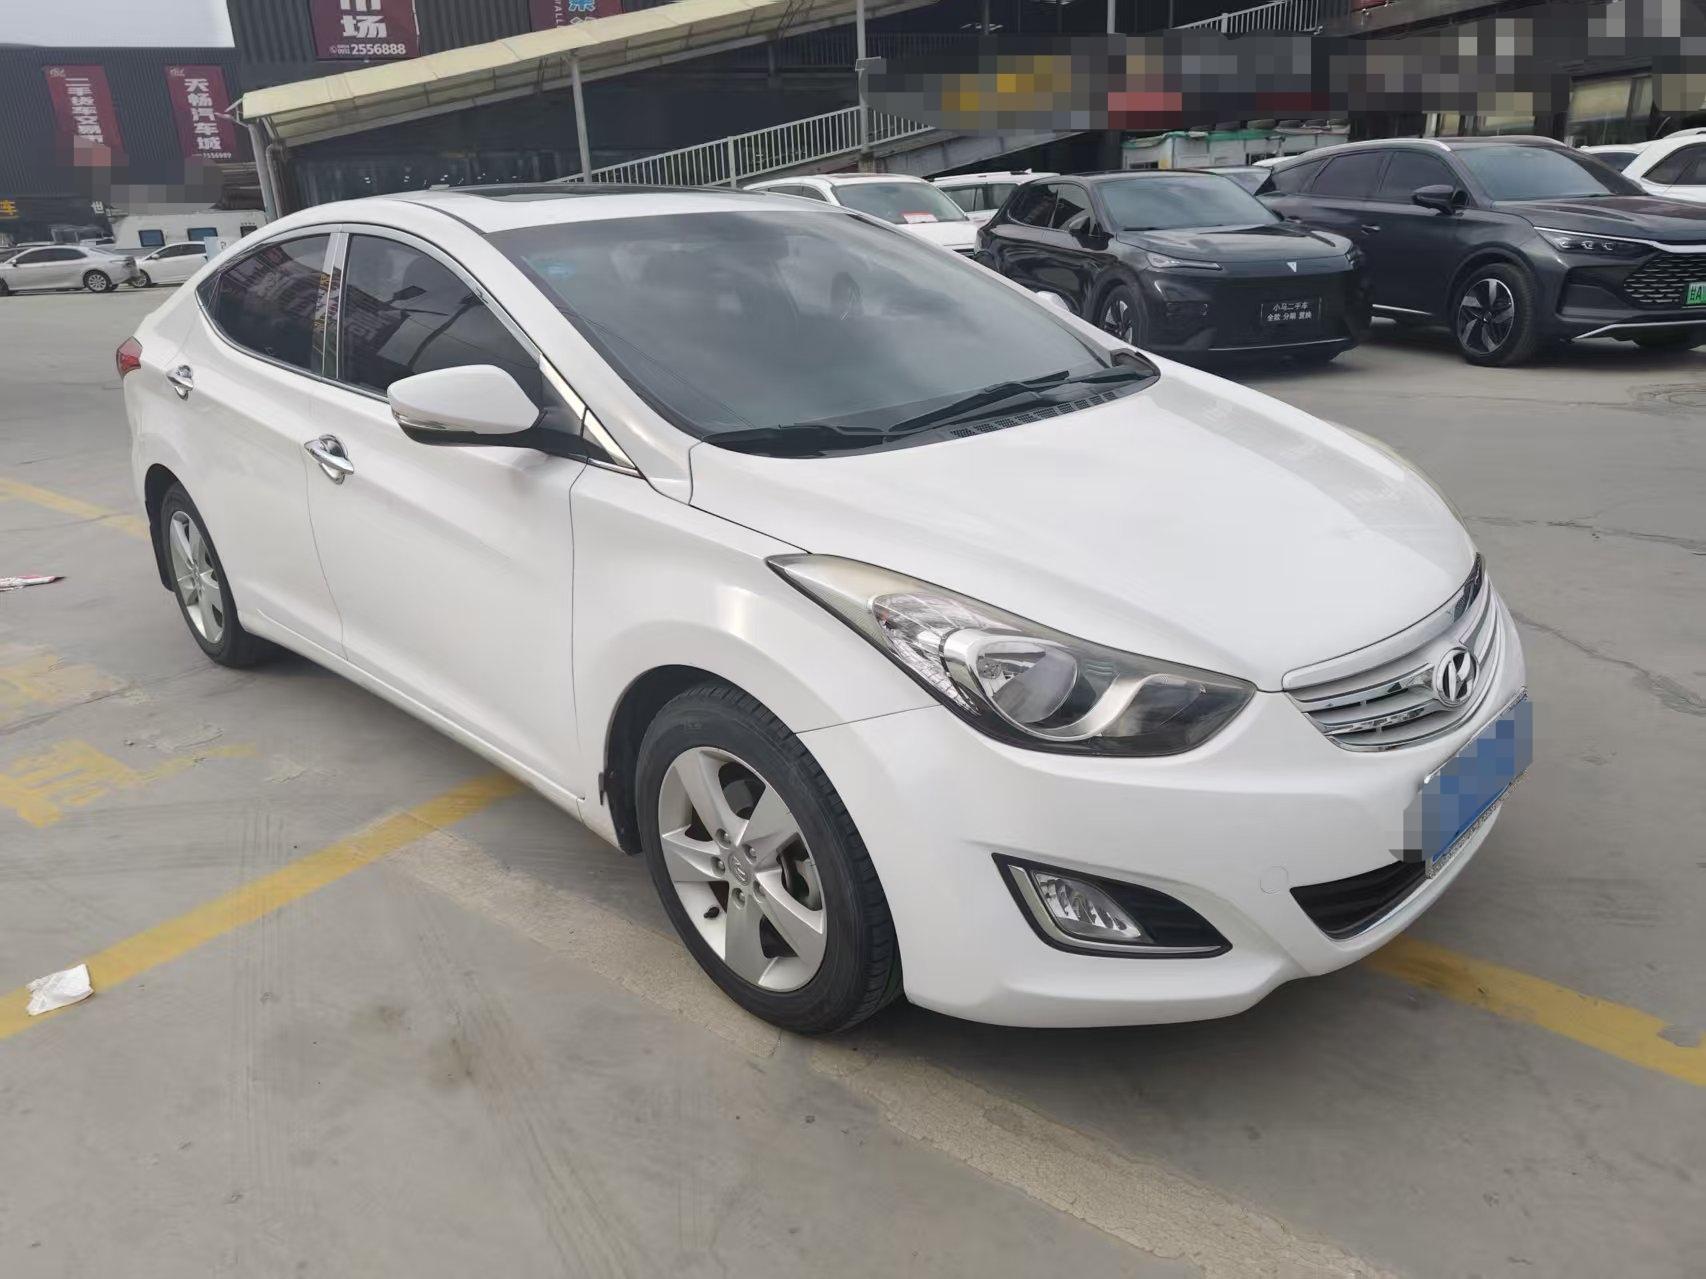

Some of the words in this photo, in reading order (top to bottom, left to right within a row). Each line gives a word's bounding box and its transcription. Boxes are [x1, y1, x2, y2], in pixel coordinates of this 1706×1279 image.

[351, 43, 406, 55] 2556888
[184, 78, 222, 150] 天畅汽车城
